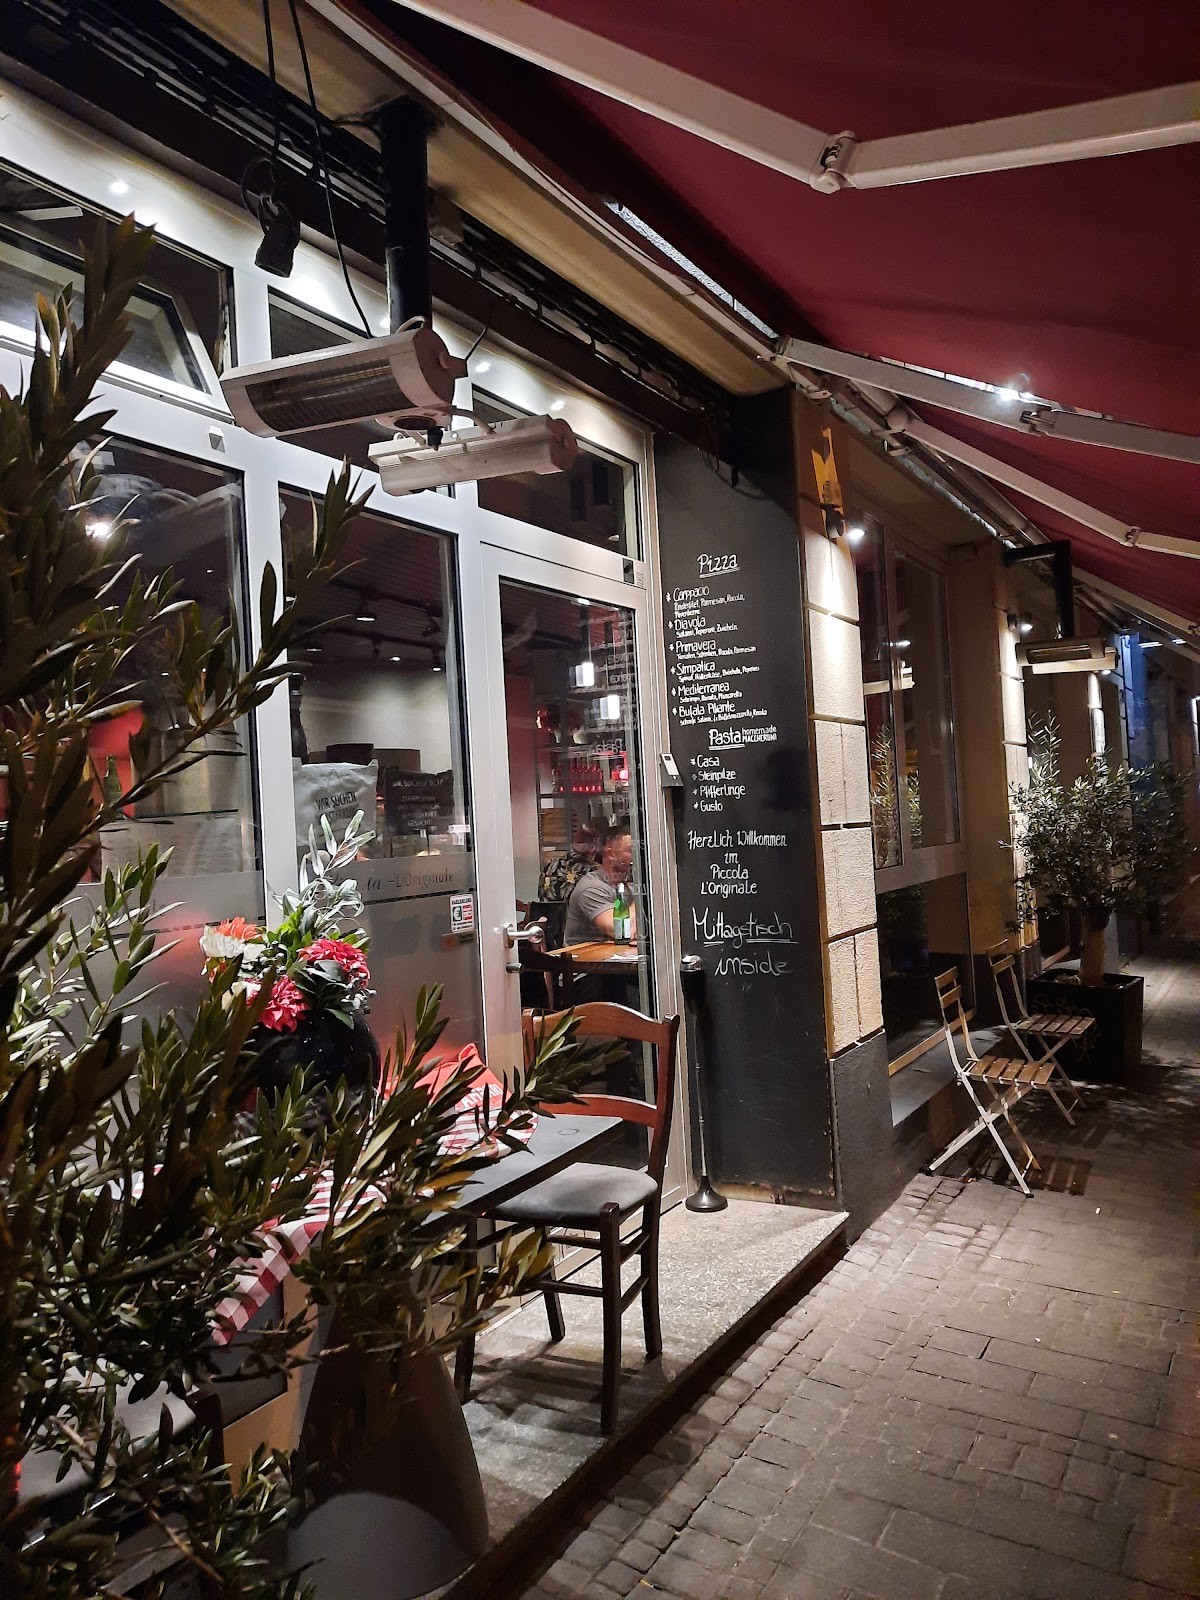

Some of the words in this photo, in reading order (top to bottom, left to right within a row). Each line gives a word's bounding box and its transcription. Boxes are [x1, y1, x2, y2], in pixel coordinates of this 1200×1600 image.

[697, 553, 739, 575] Pizza
[674, 616, 706, 631] Diavola
[675, 640, 717, 654] Primavera
[676, 660, 716, 676] Simpatica
[678, 682, 730, 697] Mediterranea
[679, 704, 705, 718] Bufala
[708, 727, 742, 746] Pasta
[741, 724, 778, 736] homemade
[696, 755, 720, 768] Casa
[700, 800, 723, 812] Gusto
[736, 830, 788, 847] Willkommen
[724, 852, 739, 864] im
[710, 864, 750, 880] Piccola
[700, 882, 758, 899] L'Originale
[692, 906, 794, 949] Mittagstisch
